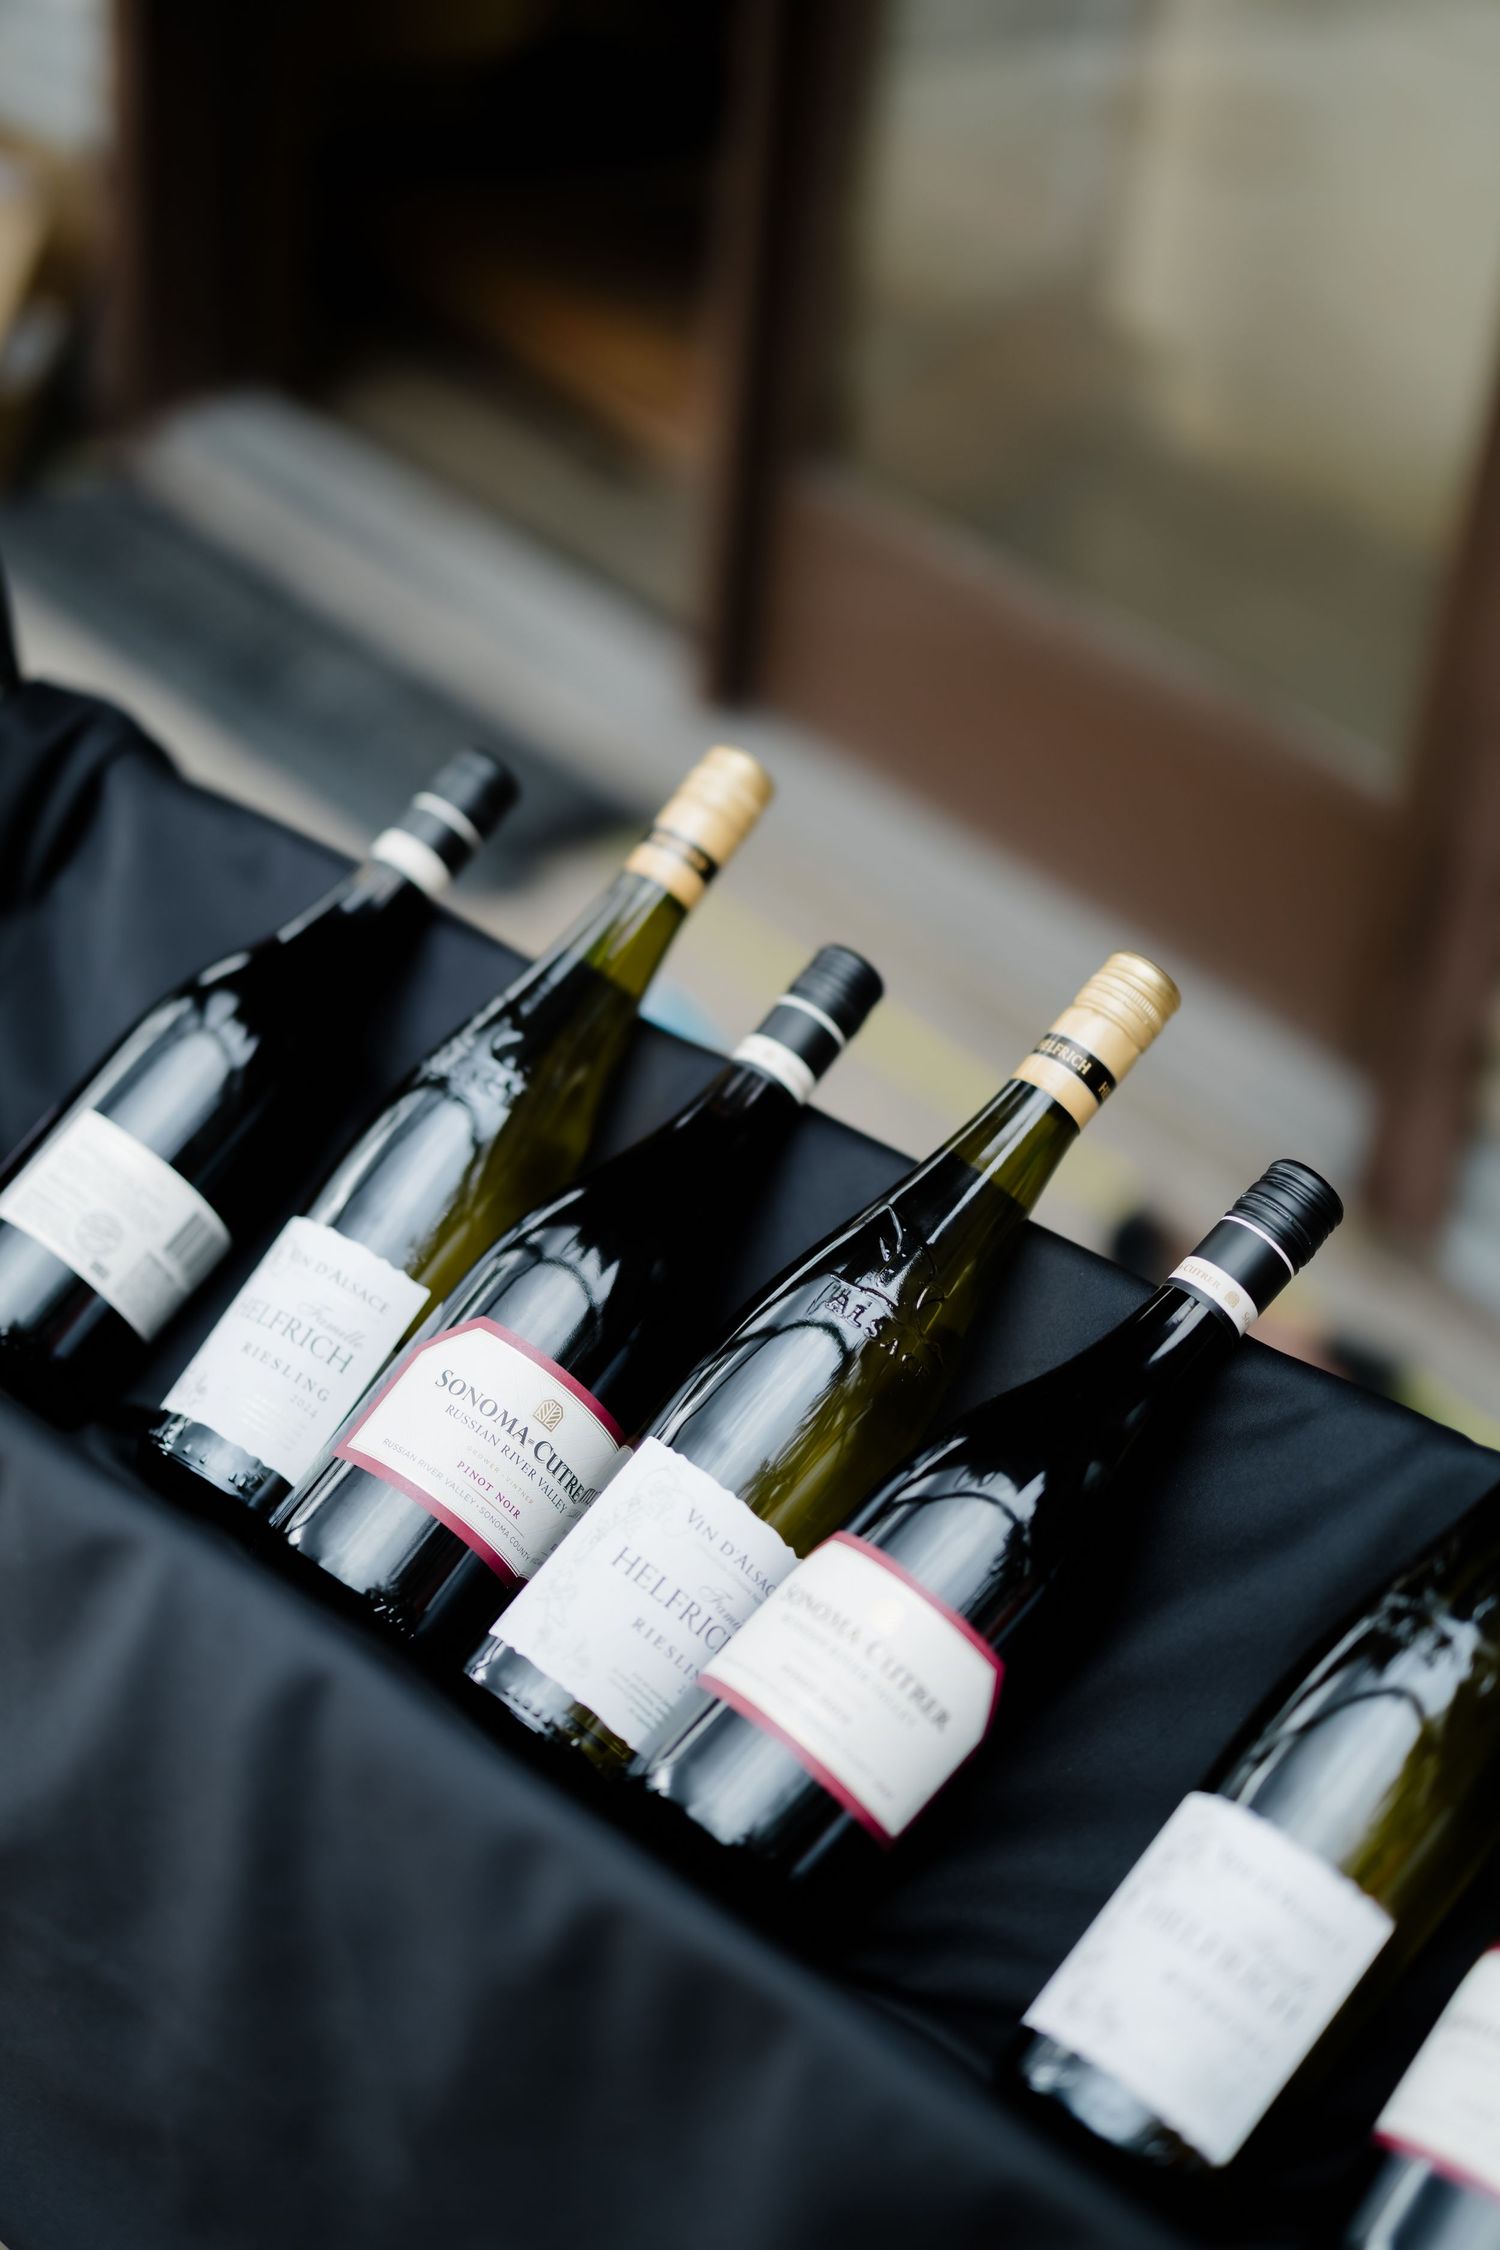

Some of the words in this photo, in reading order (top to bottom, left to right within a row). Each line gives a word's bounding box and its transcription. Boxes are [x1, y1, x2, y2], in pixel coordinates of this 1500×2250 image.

[240, 1341, 331, 1403] RIESLING
[444, 1403, 502, 1448] RUSSIAN
[500, 1443, 537, 1482] RIVER
[537, 1475, 568, 1514] VALLEY
[456, 1460, 495, 1493] PINOT
[495, 1491, 521, 1520] NOIR
[383, 1437, 417, 1462] RUSSIAN
[418, 1458, 445, 1483] RIVER
[444, 1478, 477, 1505] VALLEY
[478, 1505, 510, 1538] SONOMA
[509, 1535, 531, 1561] COUNTY
[687, 1507, 719, 1541] VIN
[719, 1540, 778, 1598] D'ALSAC
[631, 1616, 700, 1681] RIESLI
